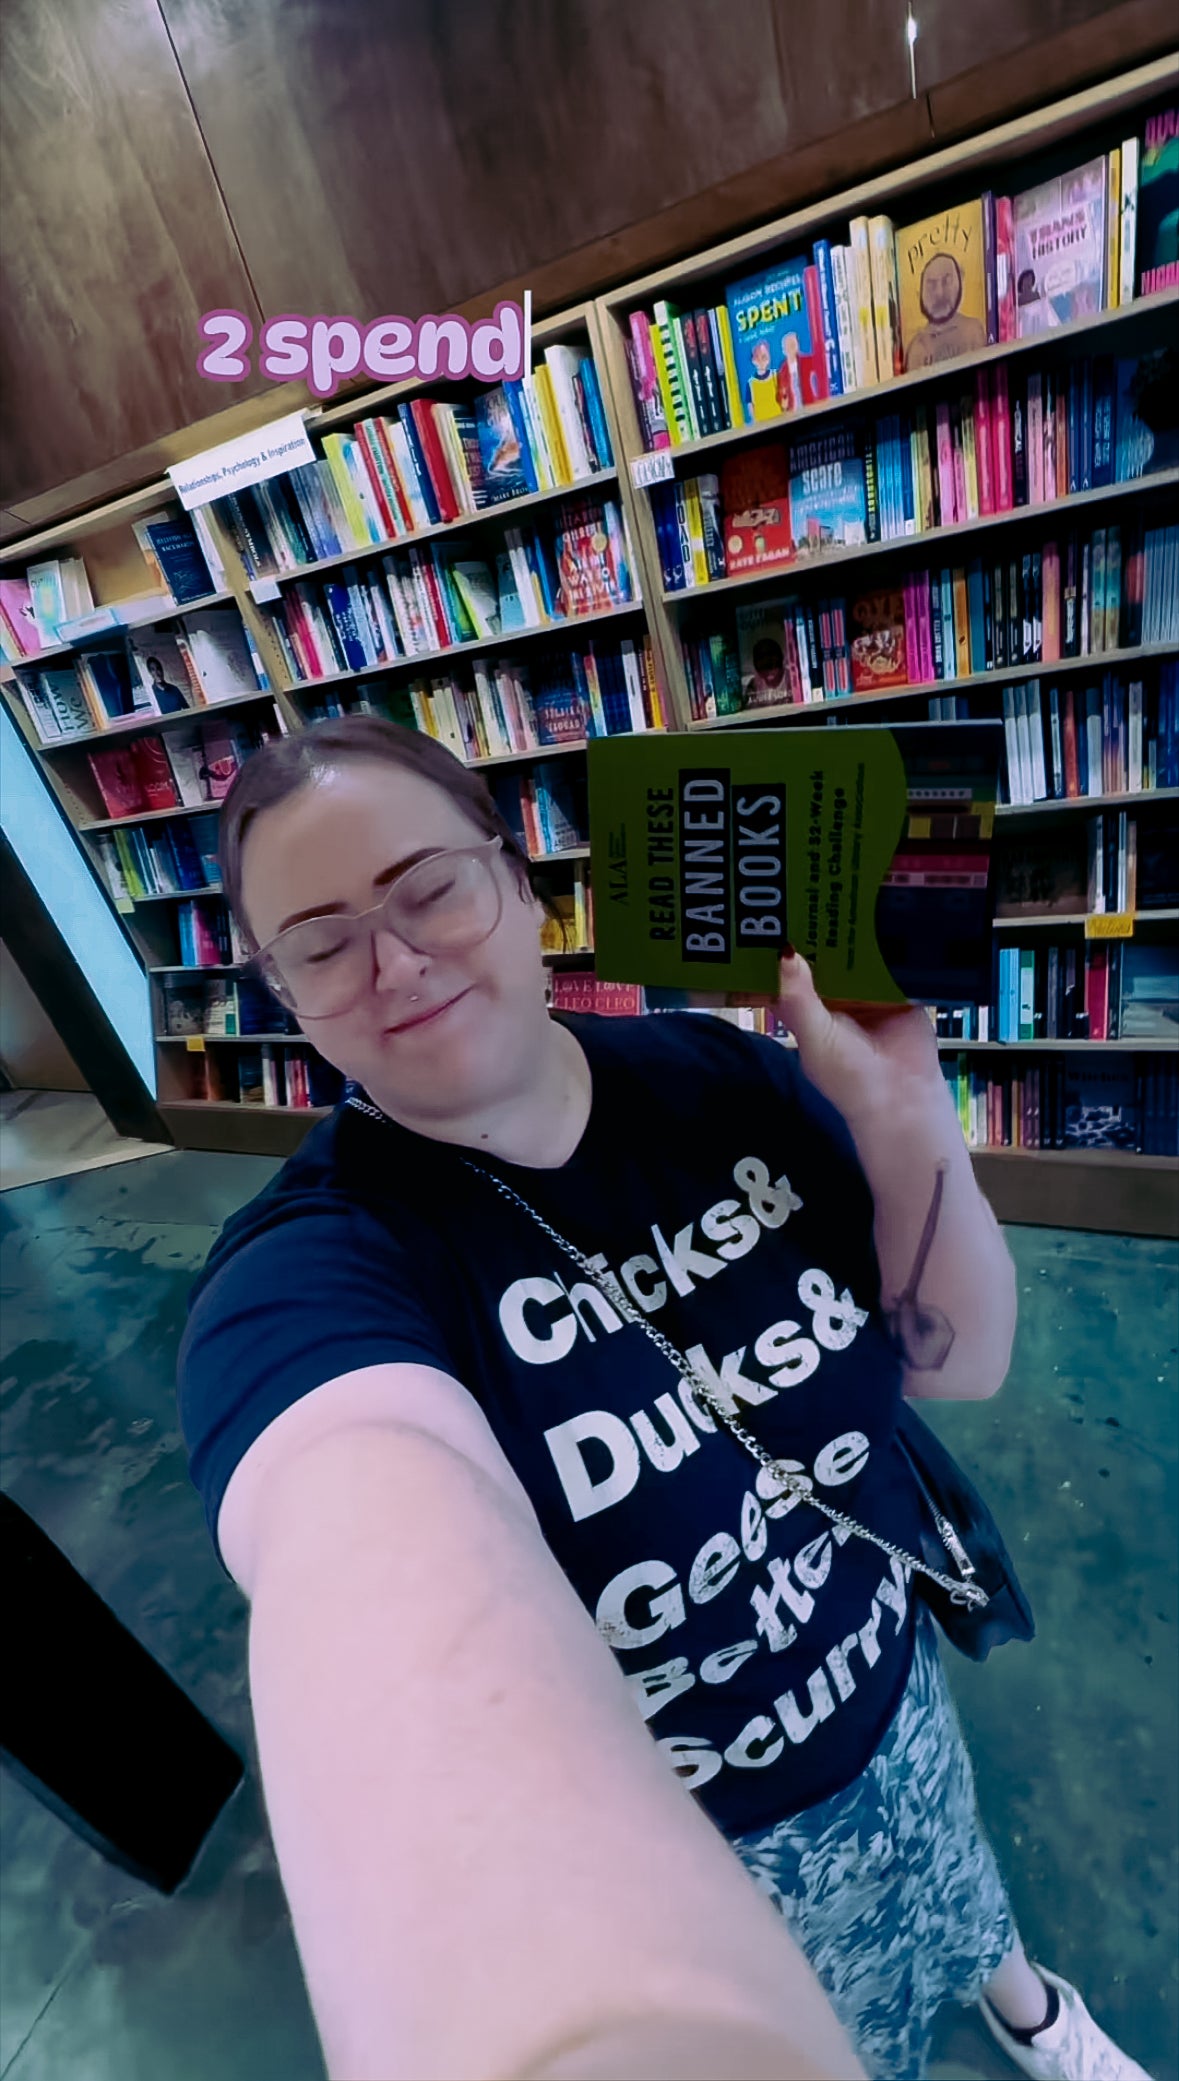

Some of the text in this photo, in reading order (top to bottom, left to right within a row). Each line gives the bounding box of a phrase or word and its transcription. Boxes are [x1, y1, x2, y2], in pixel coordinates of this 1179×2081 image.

[907, 212, 973, 275] pretty
[1032, 224, 1088, 260] HISTORY
[735, 287, 803, 333] SPENT
[222, 456, 262, 477] Psychology
[261, 451, 268, 462] &
[267, 437, 306, 458] Inspiration
[646, 787, 676, 941] READ THESE
[682, 777, 727, 954] BANNED
[735, 794, 783, 937] BOOKS
[807, 851, 820, 883] and
[825, 787, 847, 948] Reading Challenge
[805, 888, 820, 948] Journal
[596, 1431, 871, 1650] Geese
[655, 1555, 912, 1791] Scurry
